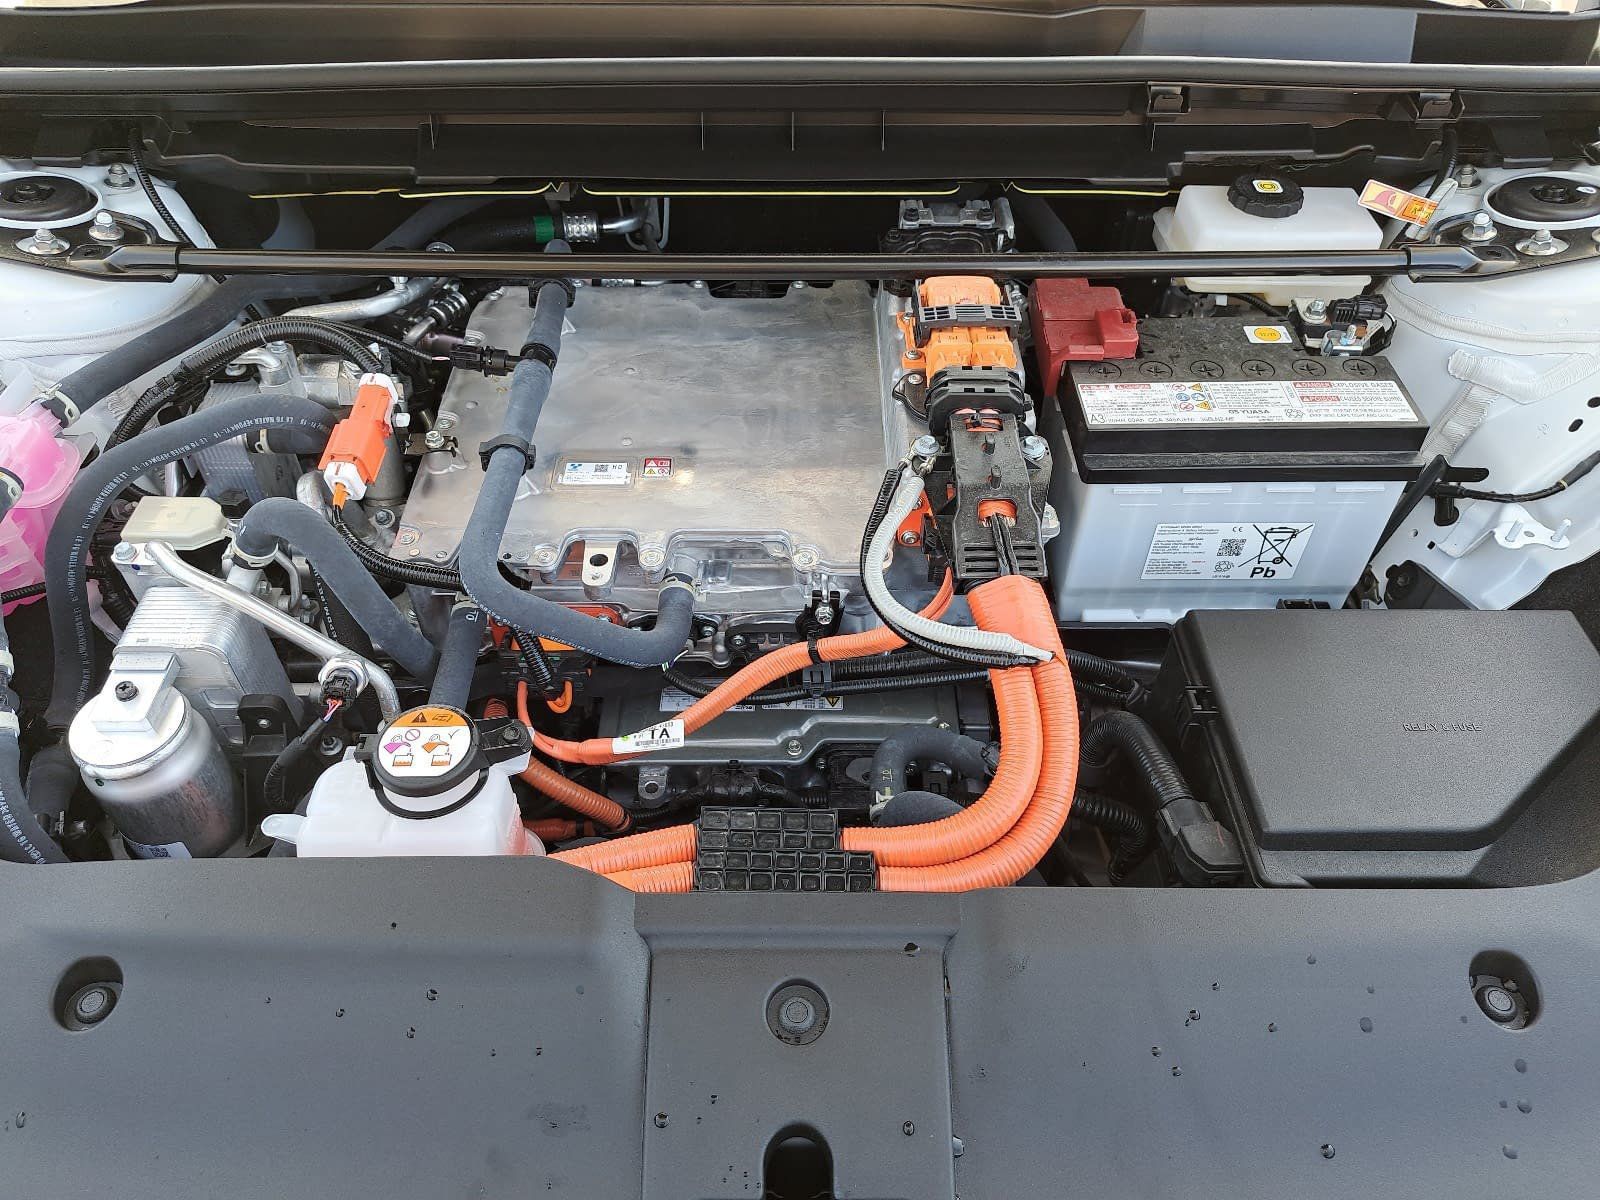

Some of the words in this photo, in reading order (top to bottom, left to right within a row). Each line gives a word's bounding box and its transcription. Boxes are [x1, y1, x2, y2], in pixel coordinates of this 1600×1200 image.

[1090, 414, 1106, 424] A3
[1249, 566, 1277, 579] Pb
[1402, 723, 1439, 733] RELAY
[1441, 723, 1450, 732] &
[1451, 723, 1482, 732] FUSE
[648, 728, 670, 740] TA
